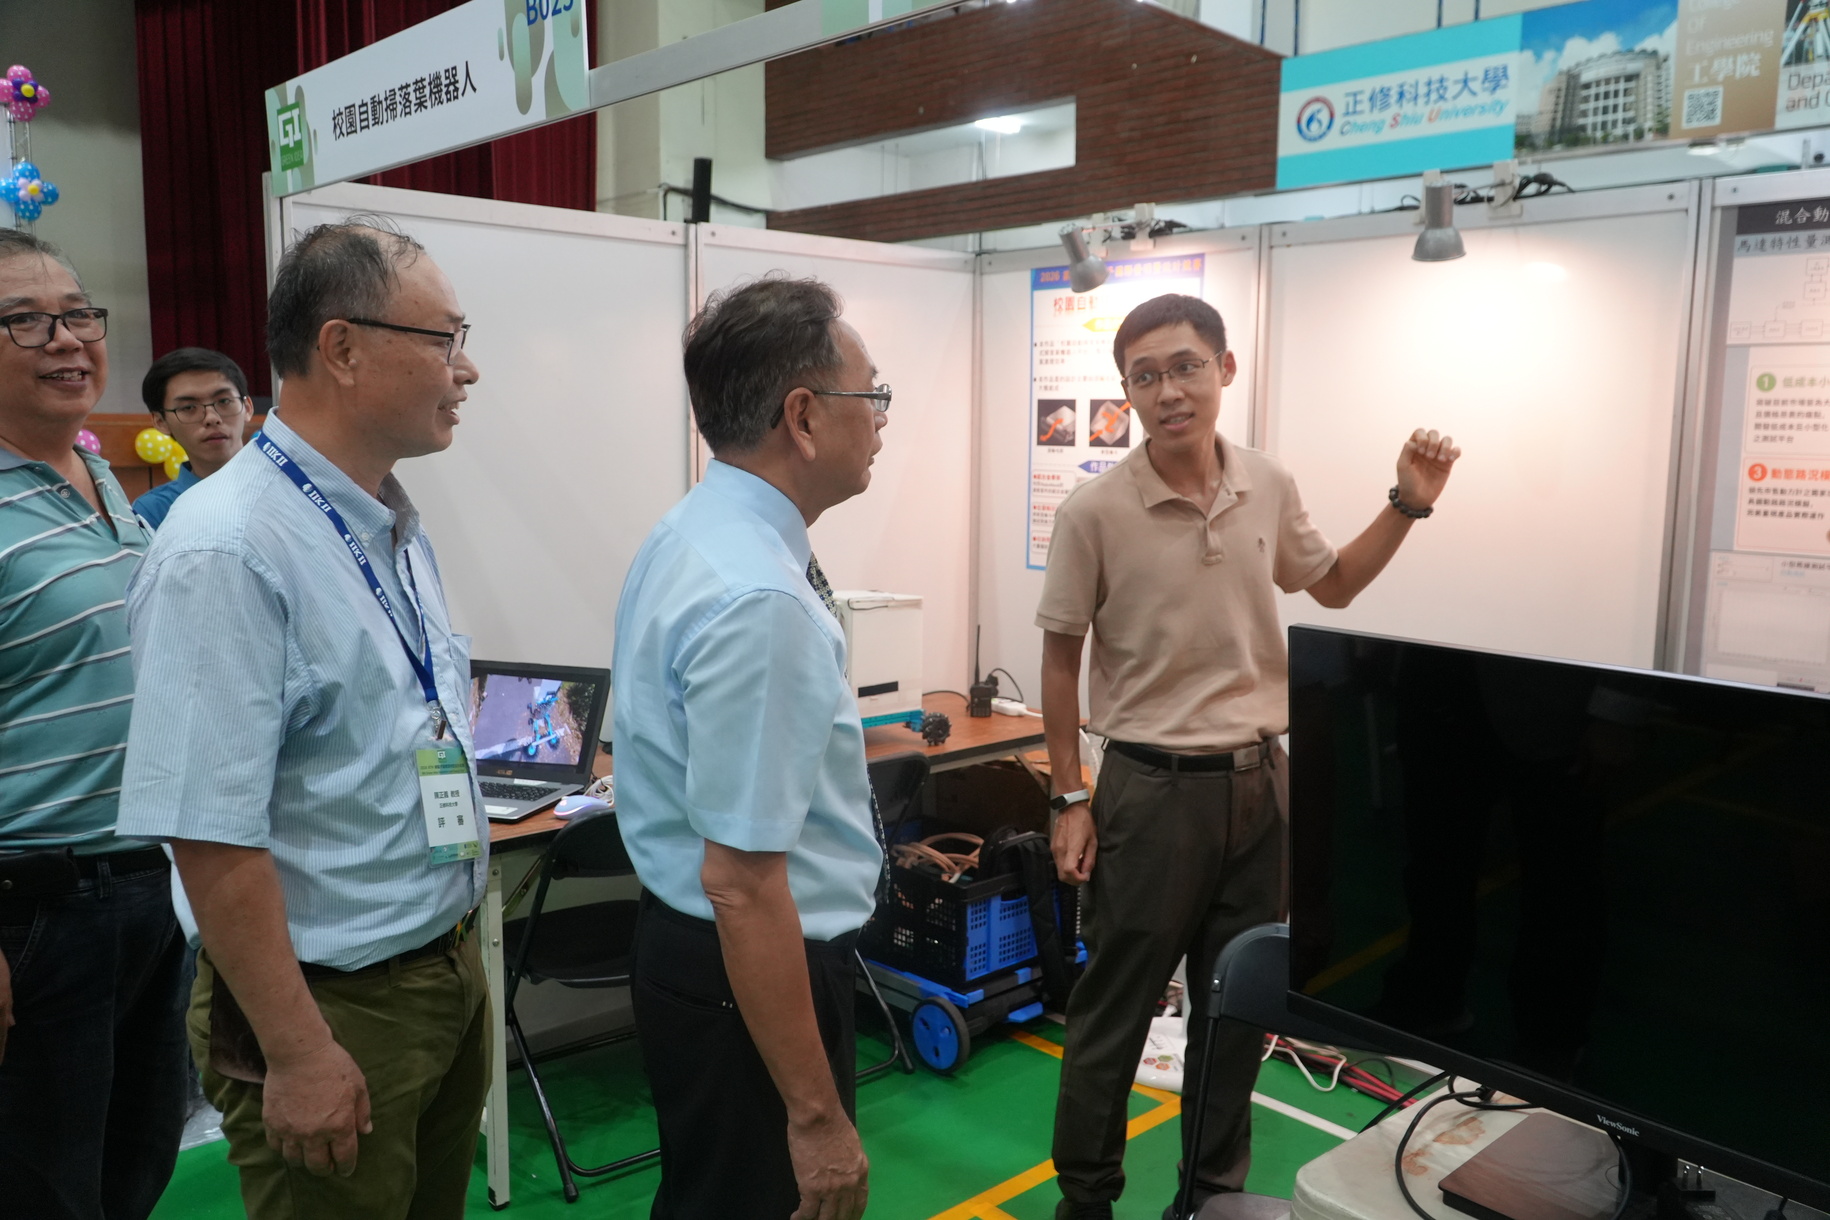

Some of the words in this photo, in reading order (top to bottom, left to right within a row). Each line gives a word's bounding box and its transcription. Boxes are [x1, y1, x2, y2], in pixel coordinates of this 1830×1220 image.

[1686, 30, 1774, 56] Engineering
[1685, 52, 1761, 84] 工學院
[332, 60, 477, 141] 校園自動掃落葉機器人
[1342, 63, 1509, 117] 正修科技大學
[1786, 90, 1820, 113] and
[1339, 114, 1386, 136] Cheng
[1390, 107, 1424, 129] Shiu
[1427, 99, 1510, 124] University
[1775, 205, 1830, 225] 混合動
[1597, 1114, 1640, 1137] ViewSonic
